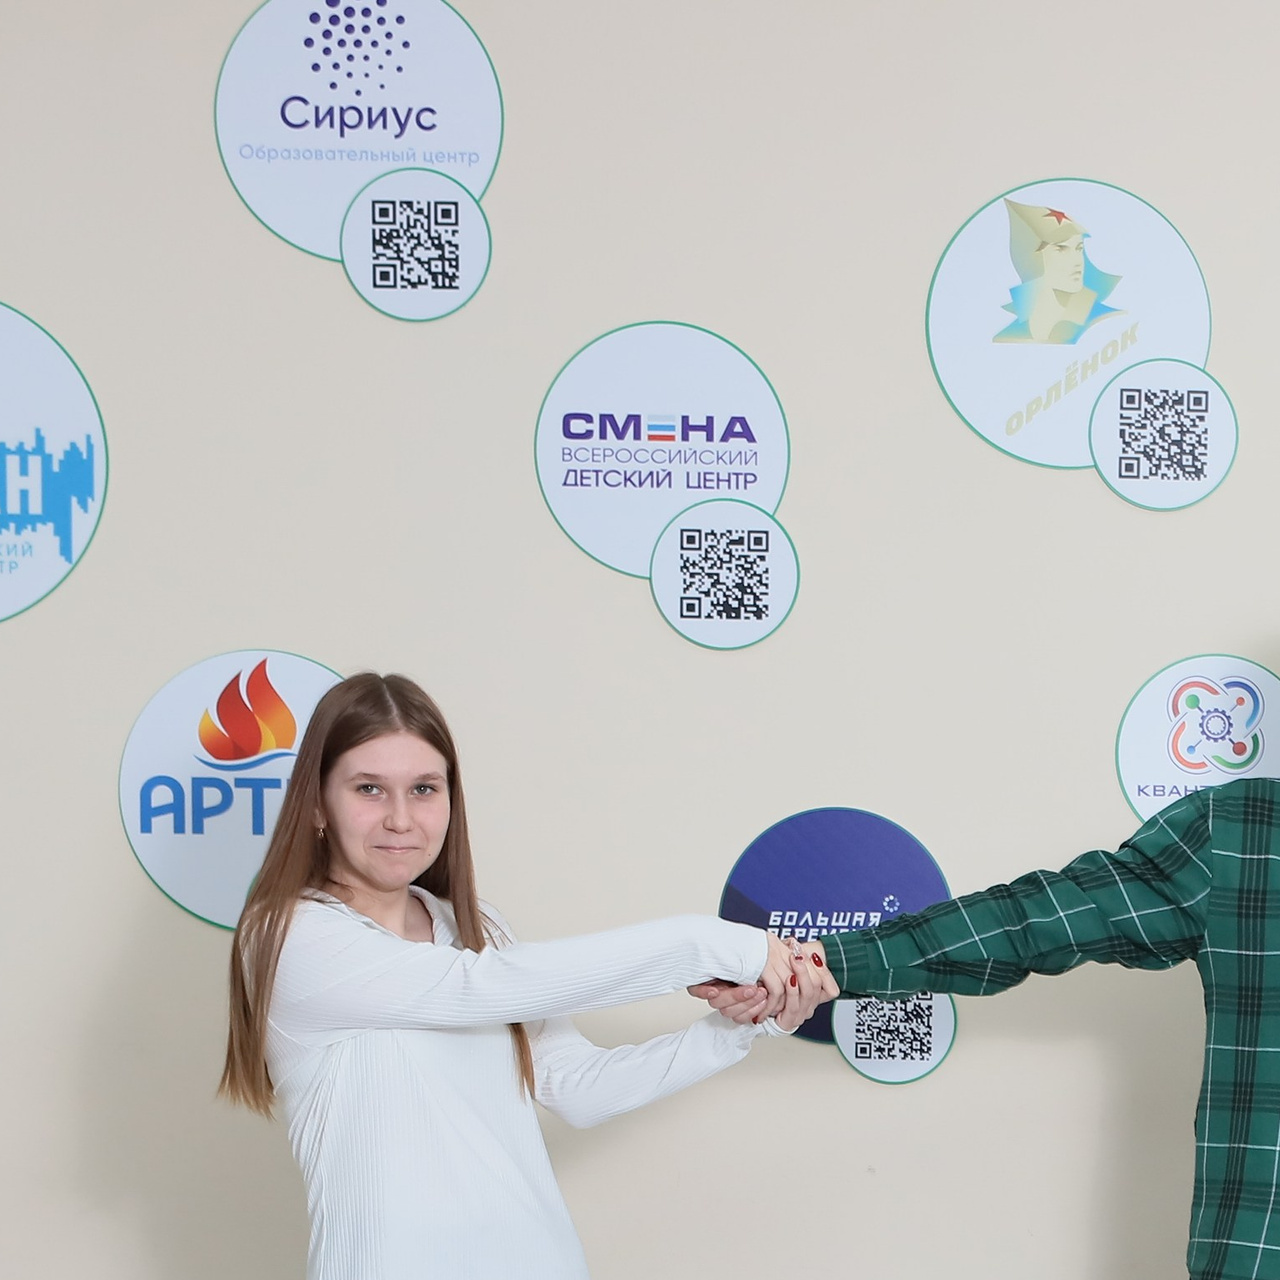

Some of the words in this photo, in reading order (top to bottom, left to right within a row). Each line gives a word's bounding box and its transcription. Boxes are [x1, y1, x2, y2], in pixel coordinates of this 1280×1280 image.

[280, 96, 437, 139] Сириус
[239, 144, 416, 163] Образовательный
[423, 150, 480, 166] центр
[1005, 321, 1140, 436] ОРЛЁНОК
[562, 447, 758, 466] ВСЕРОССИЙСКИЙ
[562, 469, 672, 488] ДЕТСКИЙ
[686, 471, 758, 490] ЦЕНТР
[1137, 785, 1210, 797] КВАН
[140, 775, 290, 835] АРТ
[768, 911, 881, 927] БОЛЬШАЯ
